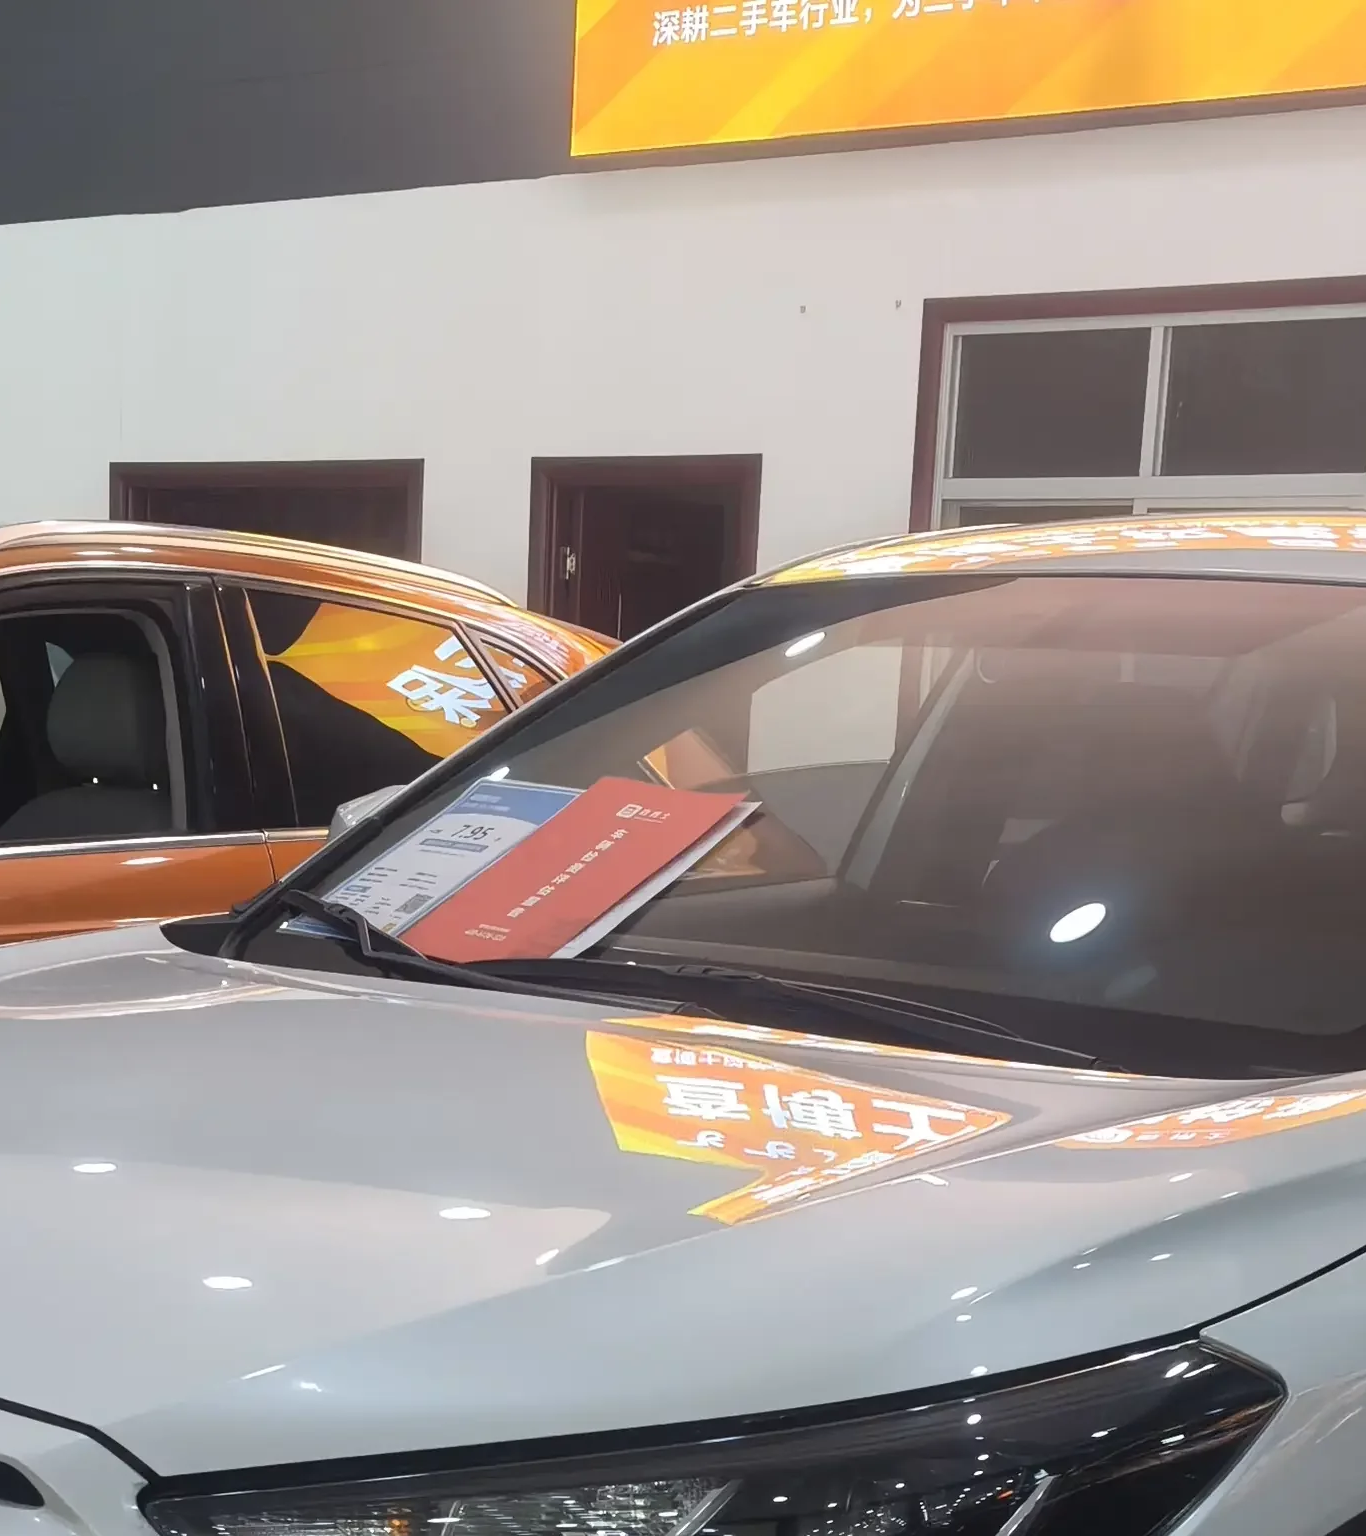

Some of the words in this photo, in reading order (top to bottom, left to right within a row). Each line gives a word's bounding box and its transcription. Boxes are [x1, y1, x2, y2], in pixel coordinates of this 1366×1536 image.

[651, 0, 1011, 47] 深耕二手车行业，为
[451, 824, 495, 842] 7.95
